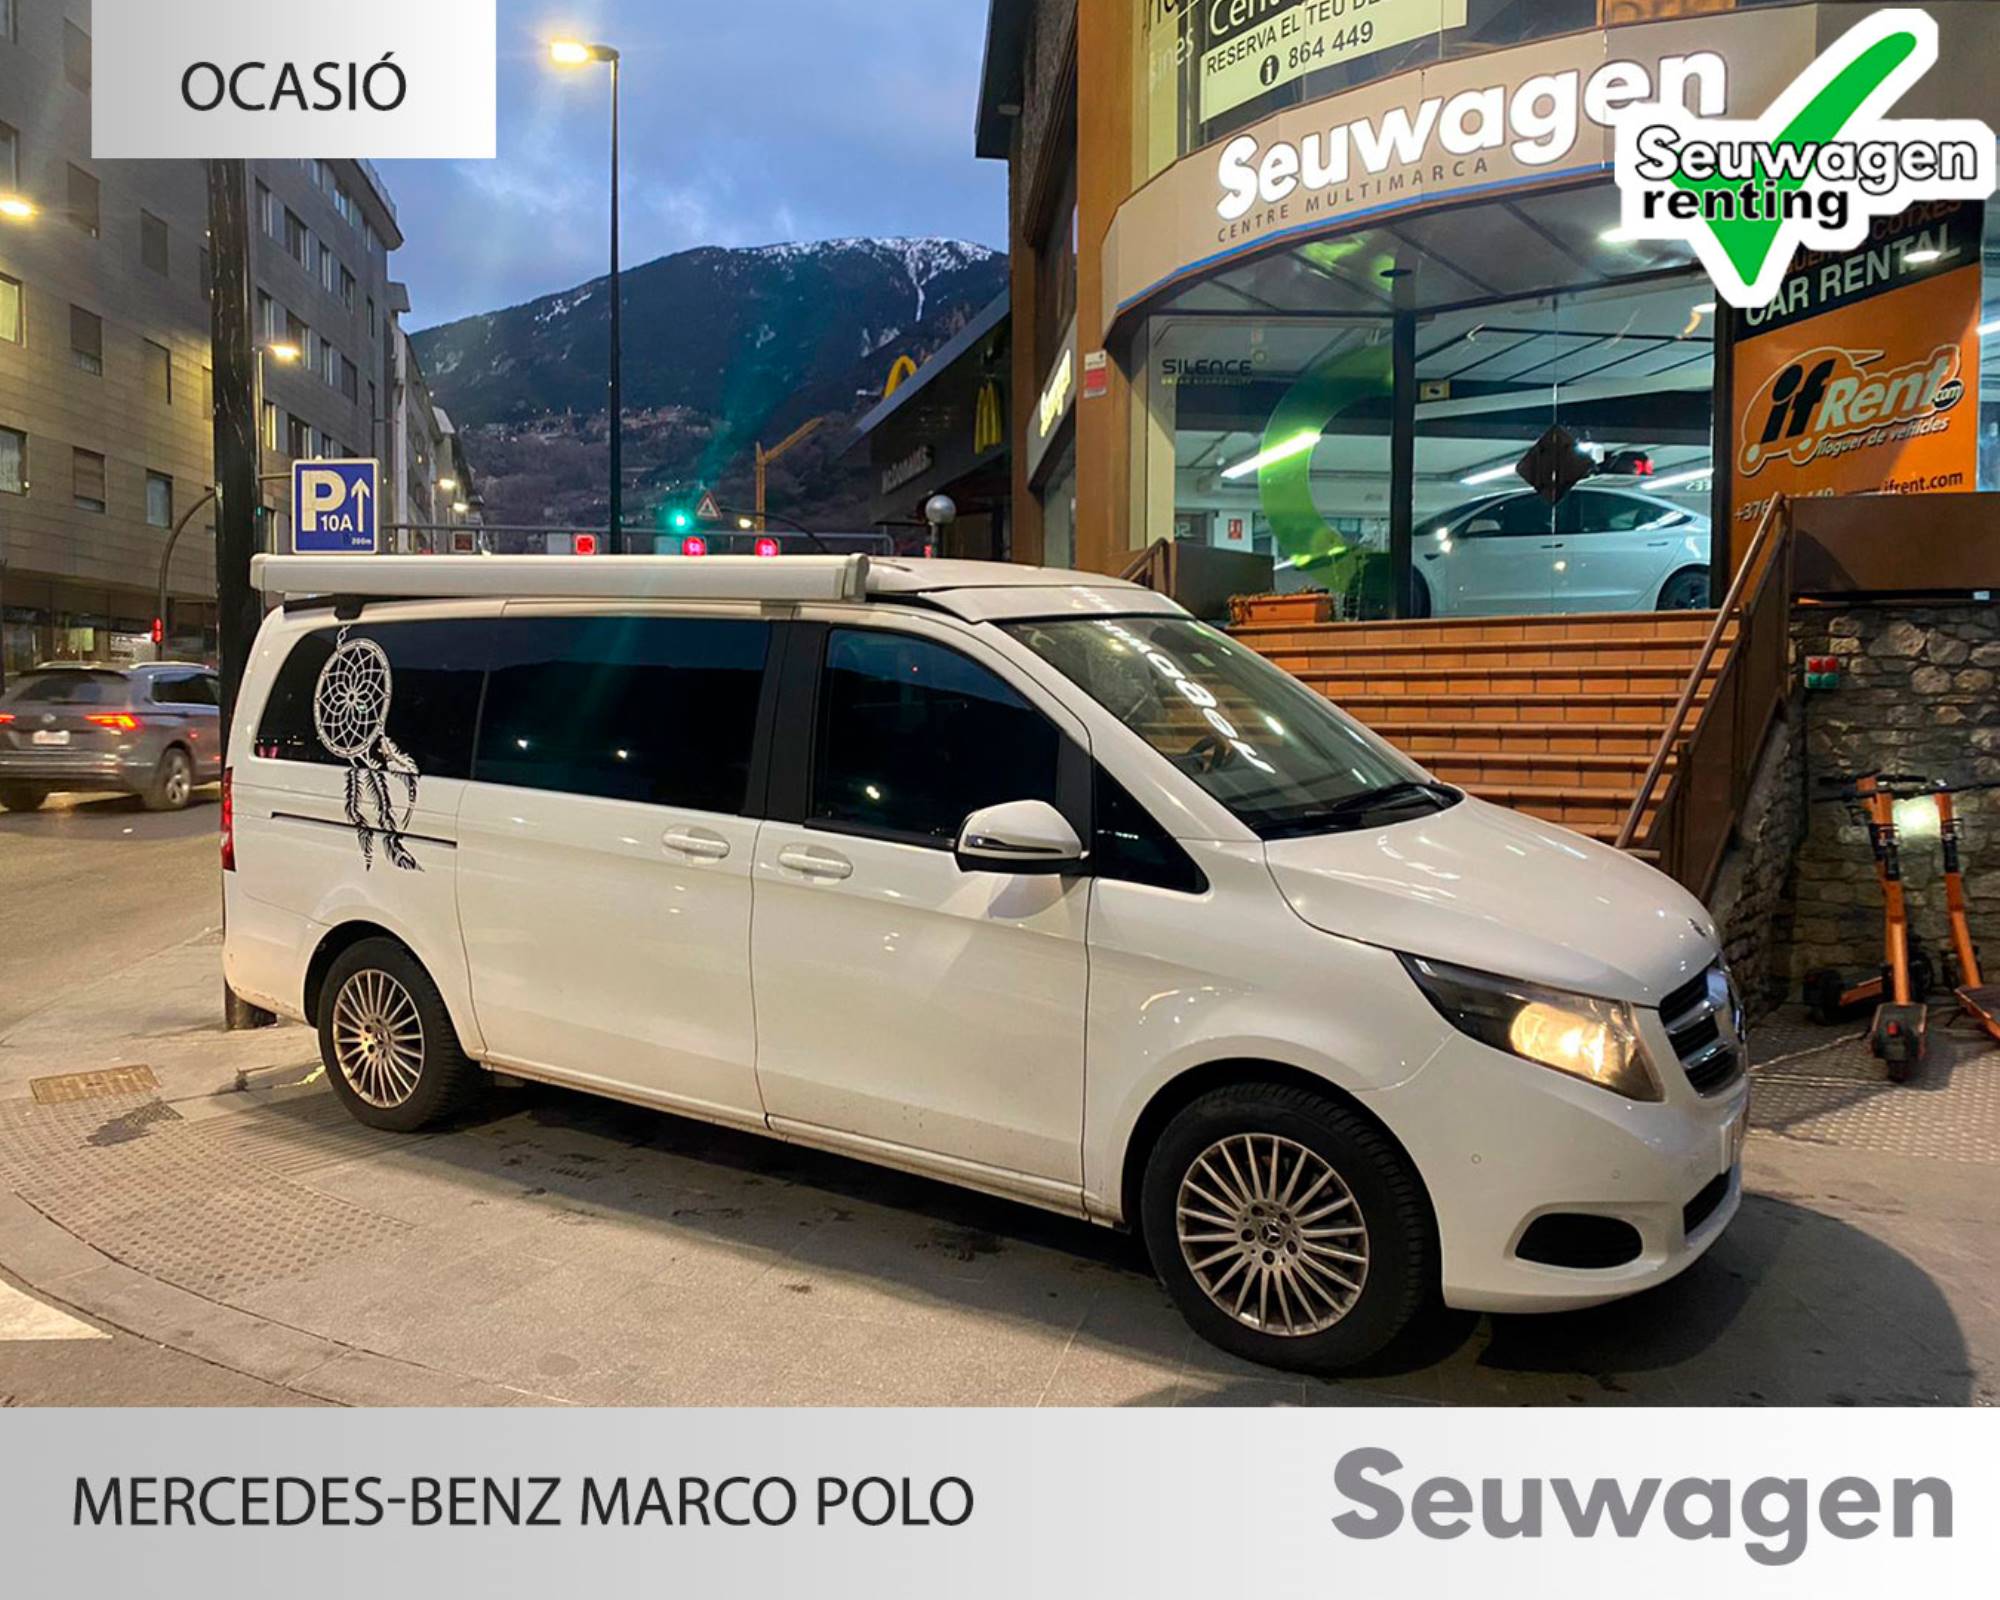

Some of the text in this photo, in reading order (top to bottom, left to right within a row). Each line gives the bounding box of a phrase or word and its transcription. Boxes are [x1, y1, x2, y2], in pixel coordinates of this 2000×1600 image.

[1207, 25, 1277, 76] RESERVA
[1281, 14, 1300, 38] EL
[1305, 0, 1345, 26] TEU
[1288, 36, 1325, 69] 864
[1332, 20, 1374, 52] 449
[1217, 50, 1727, 221] Seuwagen
[1218, 156, 1488, 243] CENTRE MULTIMARCA
[1820, 223, 1961, 302] RENTAL
[1161, 358, 1253, 376] SILENCE
[1760, 357, 1949, 444] ifRent
[1868, 428, 1887, 446] de
[302, 470, 347, 532] P
[320, 513, 354, 532] 10A
